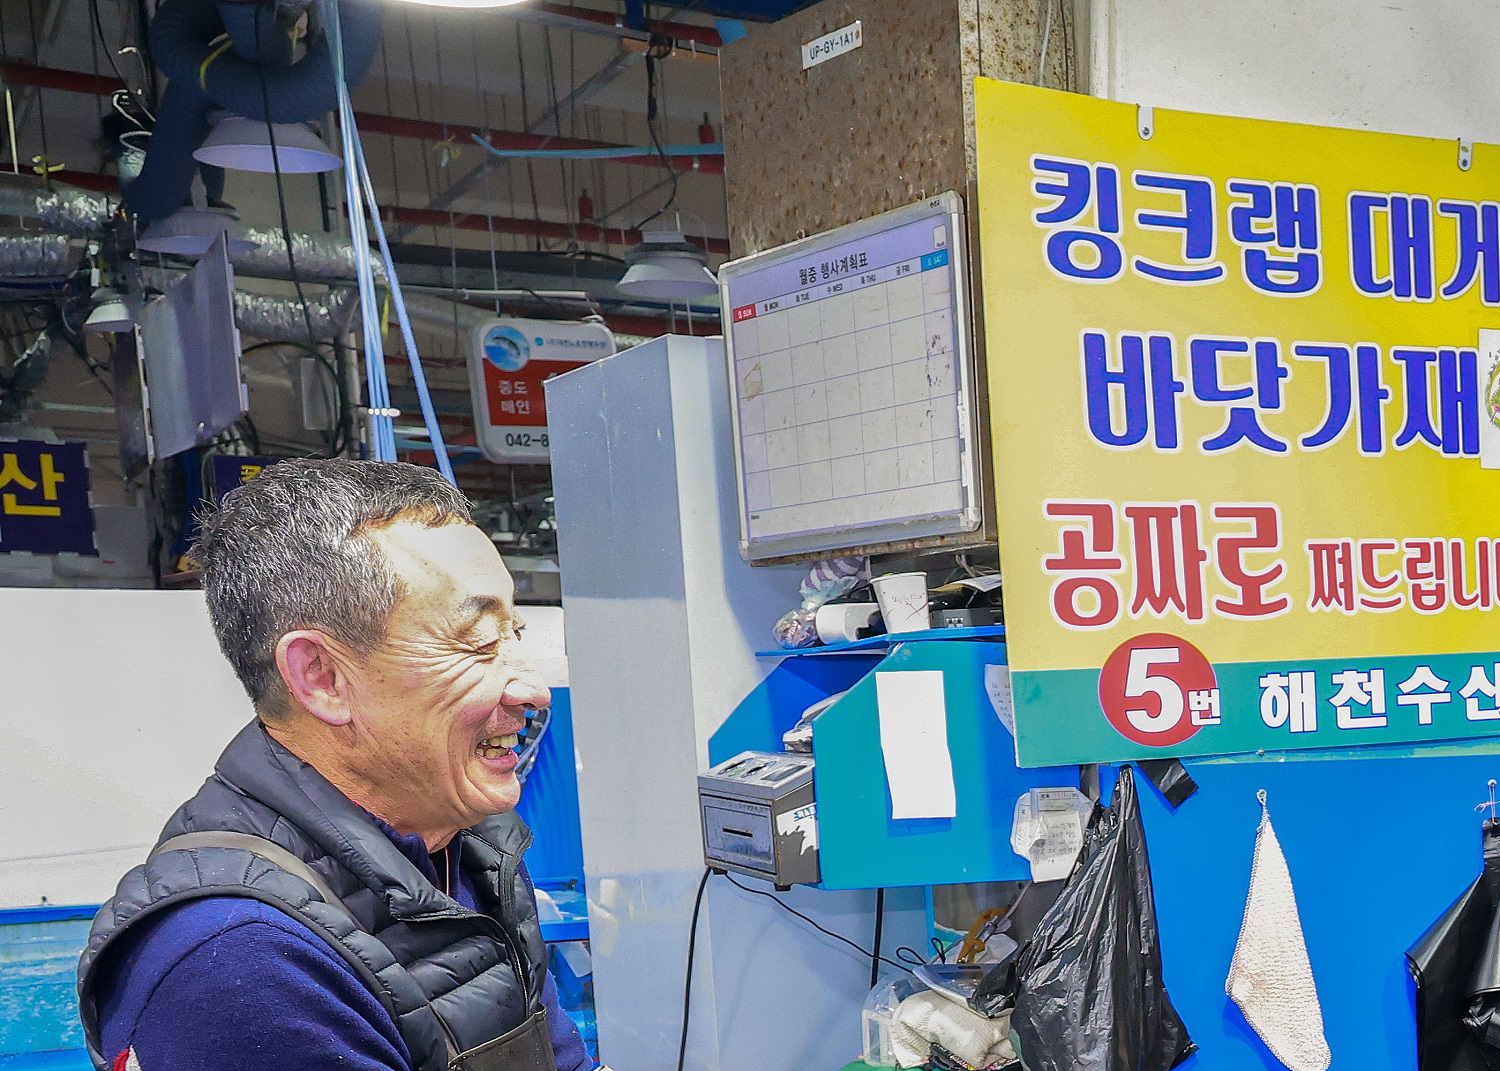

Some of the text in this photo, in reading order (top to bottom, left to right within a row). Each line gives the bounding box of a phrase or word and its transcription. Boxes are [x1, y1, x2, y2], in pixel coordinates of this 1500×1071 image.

[809, 31, 854, 60] UP-GY-1A1
[820, 251, 869, 280] 행사계획표
[1032, 155, 1321, 294] 킹크랩
[1083, 332, 1480, 455] 바닷가재
[0, 453, 65, 517] 산
[1045, 501, 1289, 628] 공짜로
